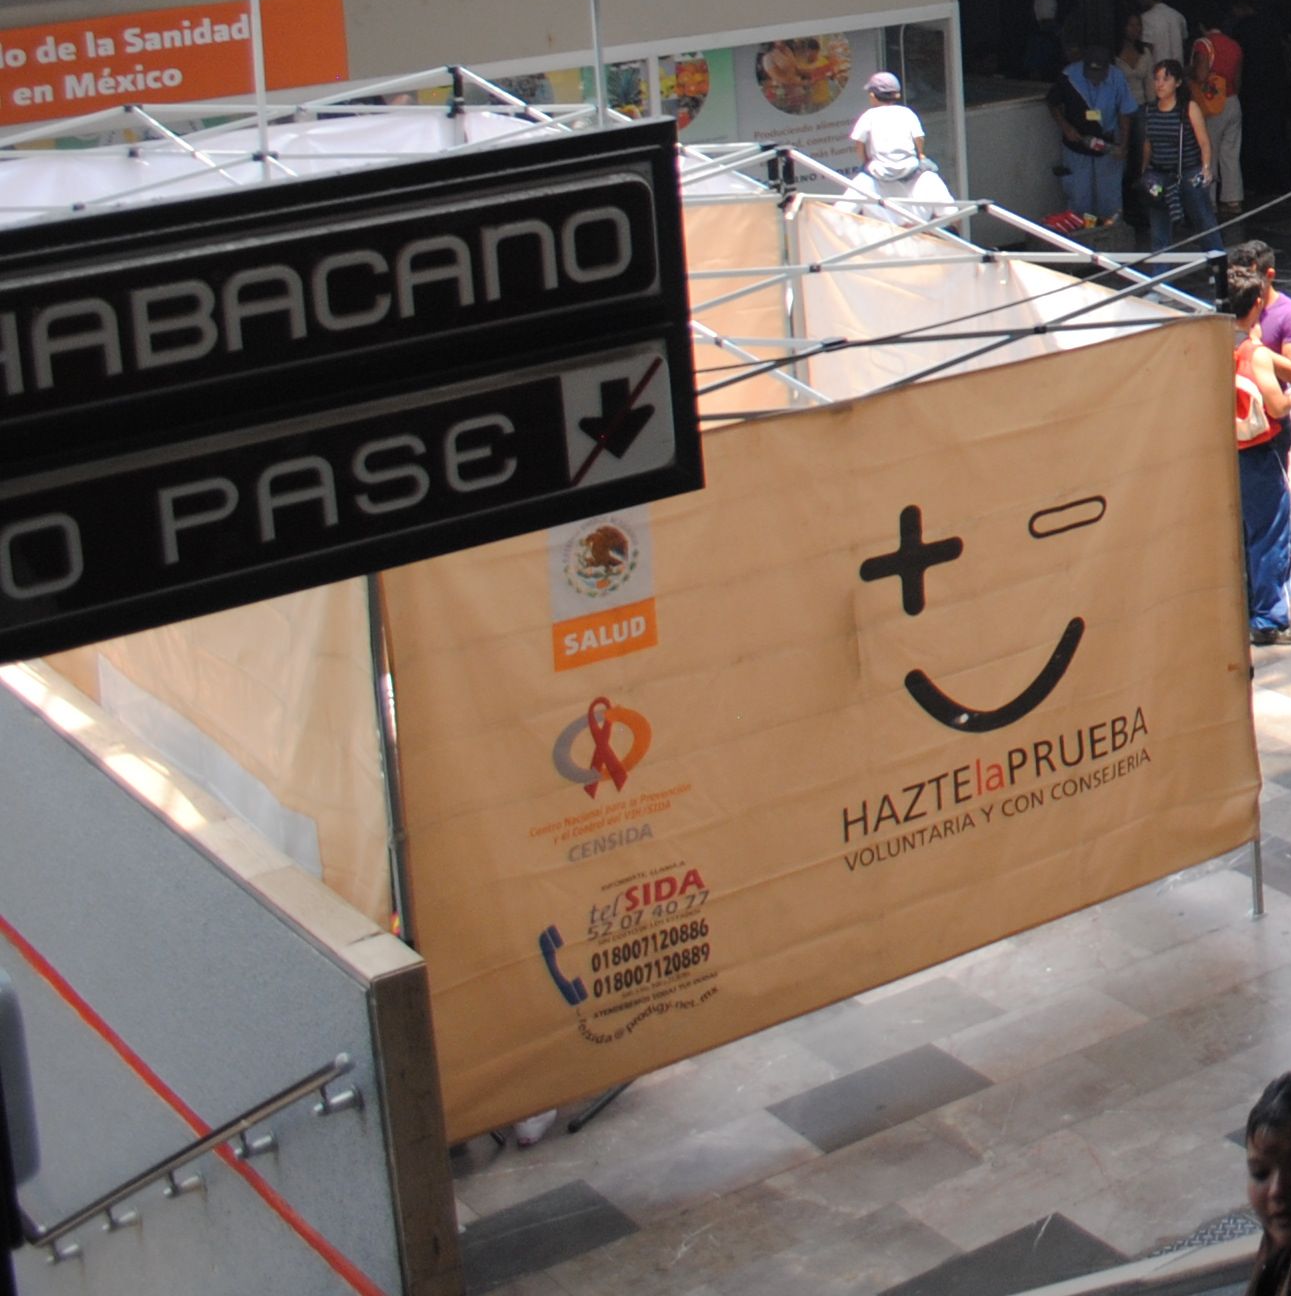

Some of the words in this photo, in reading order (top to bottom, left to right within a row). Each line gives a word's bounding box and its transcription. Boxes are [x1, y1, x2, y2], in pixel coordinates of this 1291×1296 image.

[37, 36, 77, 64] de
[86, 31, 115, 58] la
[124, 14, 251, 54] Sanidad
[13, 84, 53, 106] en
[65, 65, 183, 100] México
[158, 413, 518, 566] PASE
[564, 615, 646, 655] SALUD
[844, 813, 975, 871] VOLUNTARIA
[981, 804, 995, 823] Y
[1001, 789, 1044, 817] CON
[1051, 747, 1151, 801] CONSEJERIA
[568, 823, 654, 862] CENSIDA
[588, 921, 612, 942] 52
[620, 909, 644, 930] 07
[652, 900, 678, 917] 40
[685, 890, 710, 909] 77
[591, 918, 709, 973] 018007120886
[593, 943, 710, 998] 018007120889
